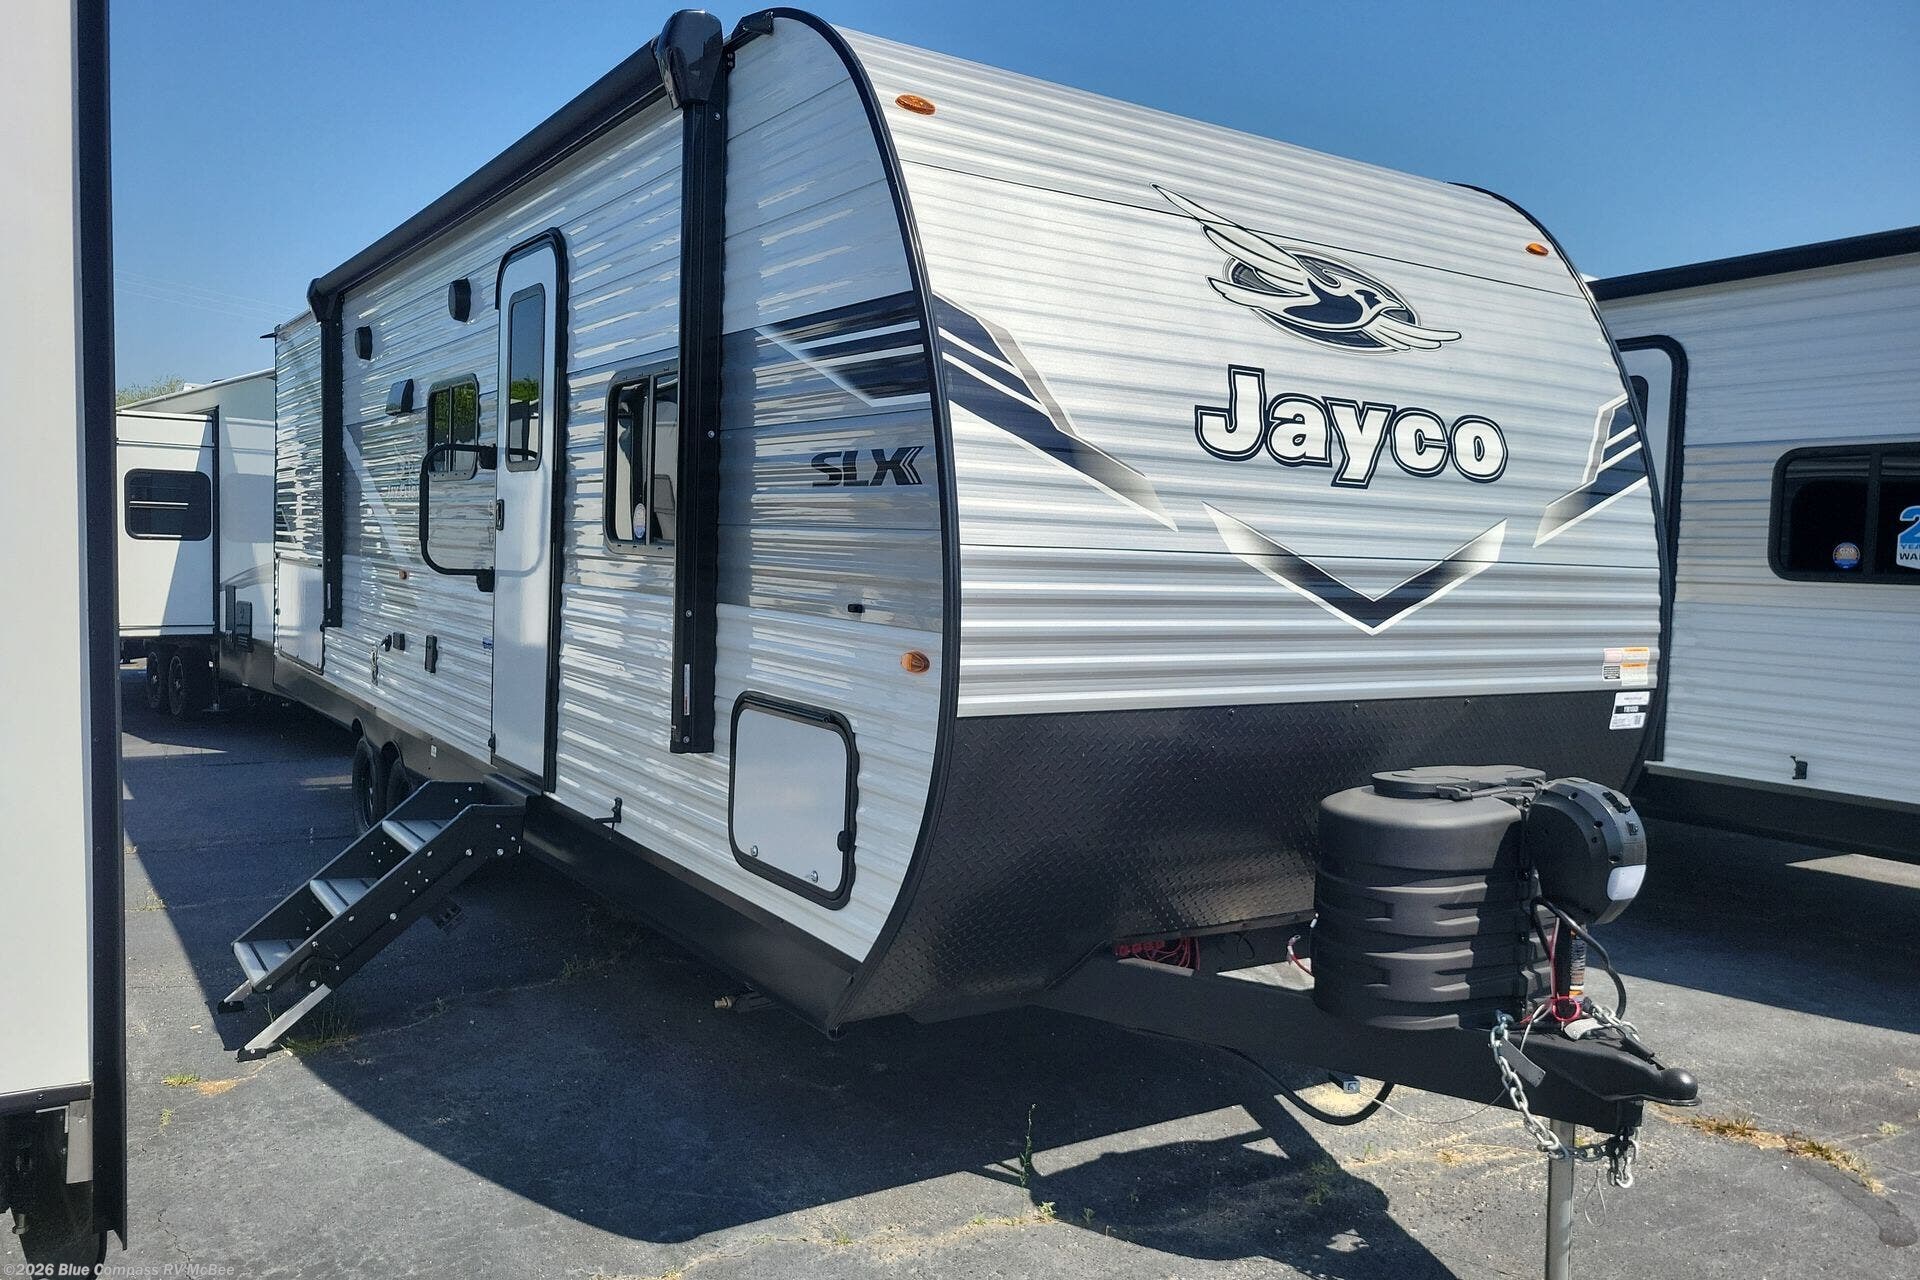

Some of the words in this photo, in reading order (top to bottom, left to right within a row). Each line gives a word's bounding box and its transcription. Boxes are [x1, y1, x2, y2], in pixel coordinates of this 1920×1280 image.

[1195, 364, 1509, 490] Jayco
[811, 446, 924, 487] SLX
[1900, 552, 1920, 560] WA
